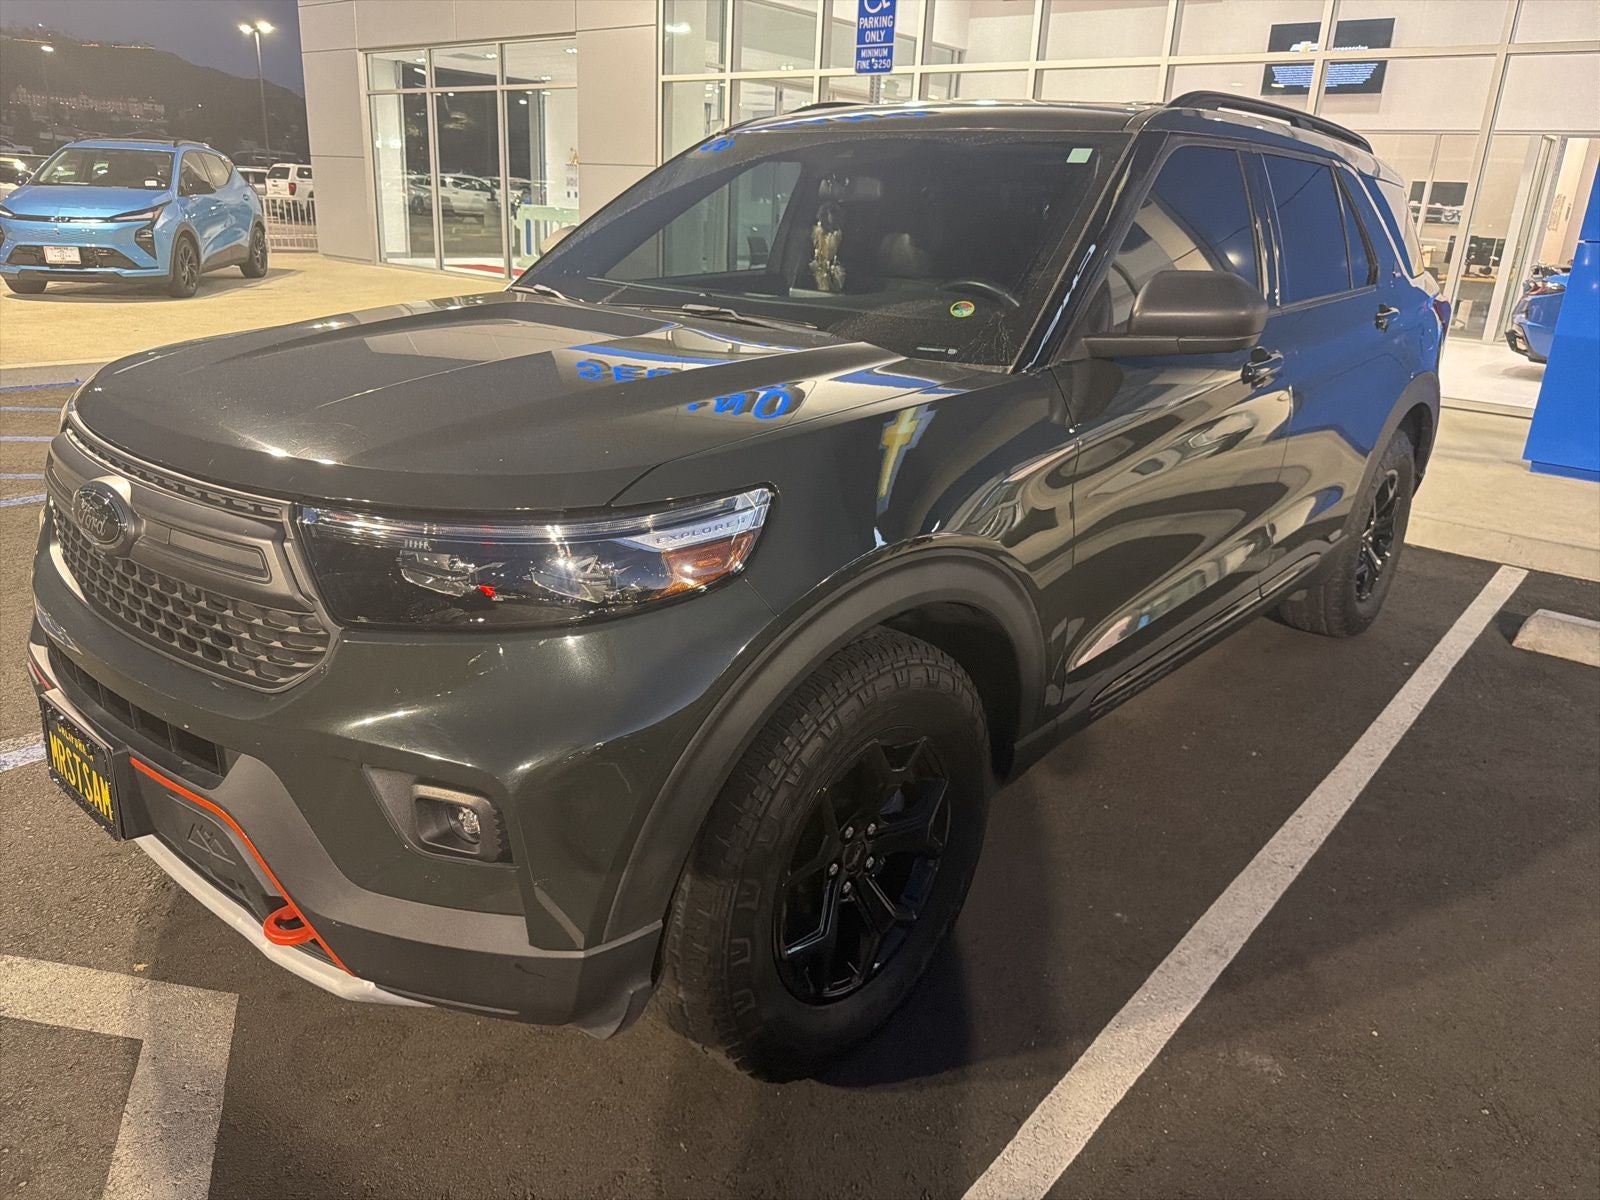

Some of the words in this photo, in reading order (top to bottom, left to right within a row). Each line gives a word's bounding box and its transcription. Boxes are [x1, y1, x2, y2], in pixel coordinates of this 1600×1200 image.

[859, 15, 893, 29] PARKING
[864, 30, 886, 43] ONLY
[860, 47, 888, 58] MINIMUM
[856, 60, 871, 70] FINE
[656, 517, 746, 544] EXPLORER
[49, 730, 113, 821] MRSTSAM
